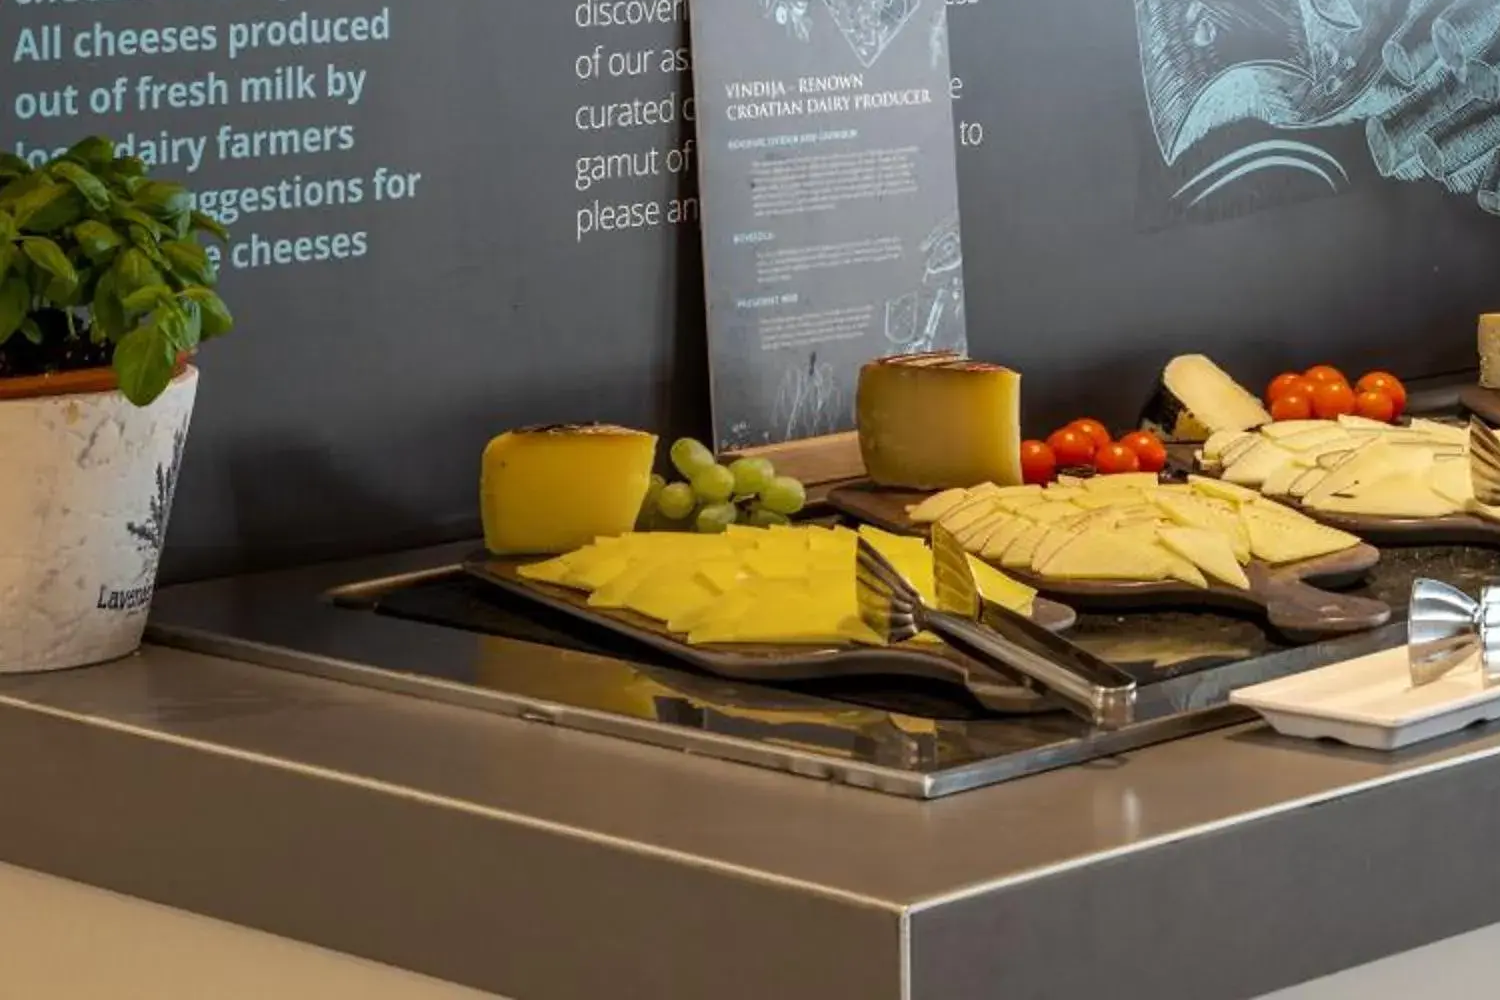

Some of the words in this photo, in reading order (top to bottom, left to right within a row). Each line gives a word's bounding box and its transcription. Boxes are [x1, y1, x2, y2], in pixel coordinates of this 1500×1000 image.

[14, 25, 60, 62] All
[75, 23, 216, 57] cheeses
[230, 7, 389, 58] produced
[576, 45, 603, 78] of
[609, 50, 653, 76] our
[16, 86, 78, 118] out
[90, 77, 128, 113] of
[136, 72, 227, 110] fresh
[242, 66, 315, 102] milk
[328, 64, 366, 104] by
[726, 81, 785, 98] VINDIJA
[800, 74, 862, 92] RENOWN
[727, 100, 802, 119] CROATIAN
[808, 96, 850, 113] DAIRY
[855, 89, 931, 109] PRODUCER
[576, 93, 674, 130] curated
[114, 131, 206, 172] dairy
[217, 125, 353, 158] farmers
[576, 148, 658, 190] gamut
[666, 140, 694, 172] of
[960, 121, 982, 145] to
[188, 176, 363, 224] ggestions
[373, 168, 421, 200] for
[577, 200, 659, 241] please
[667, 198, 698, 223] an
[233, 232, 366, 267] cheeses
